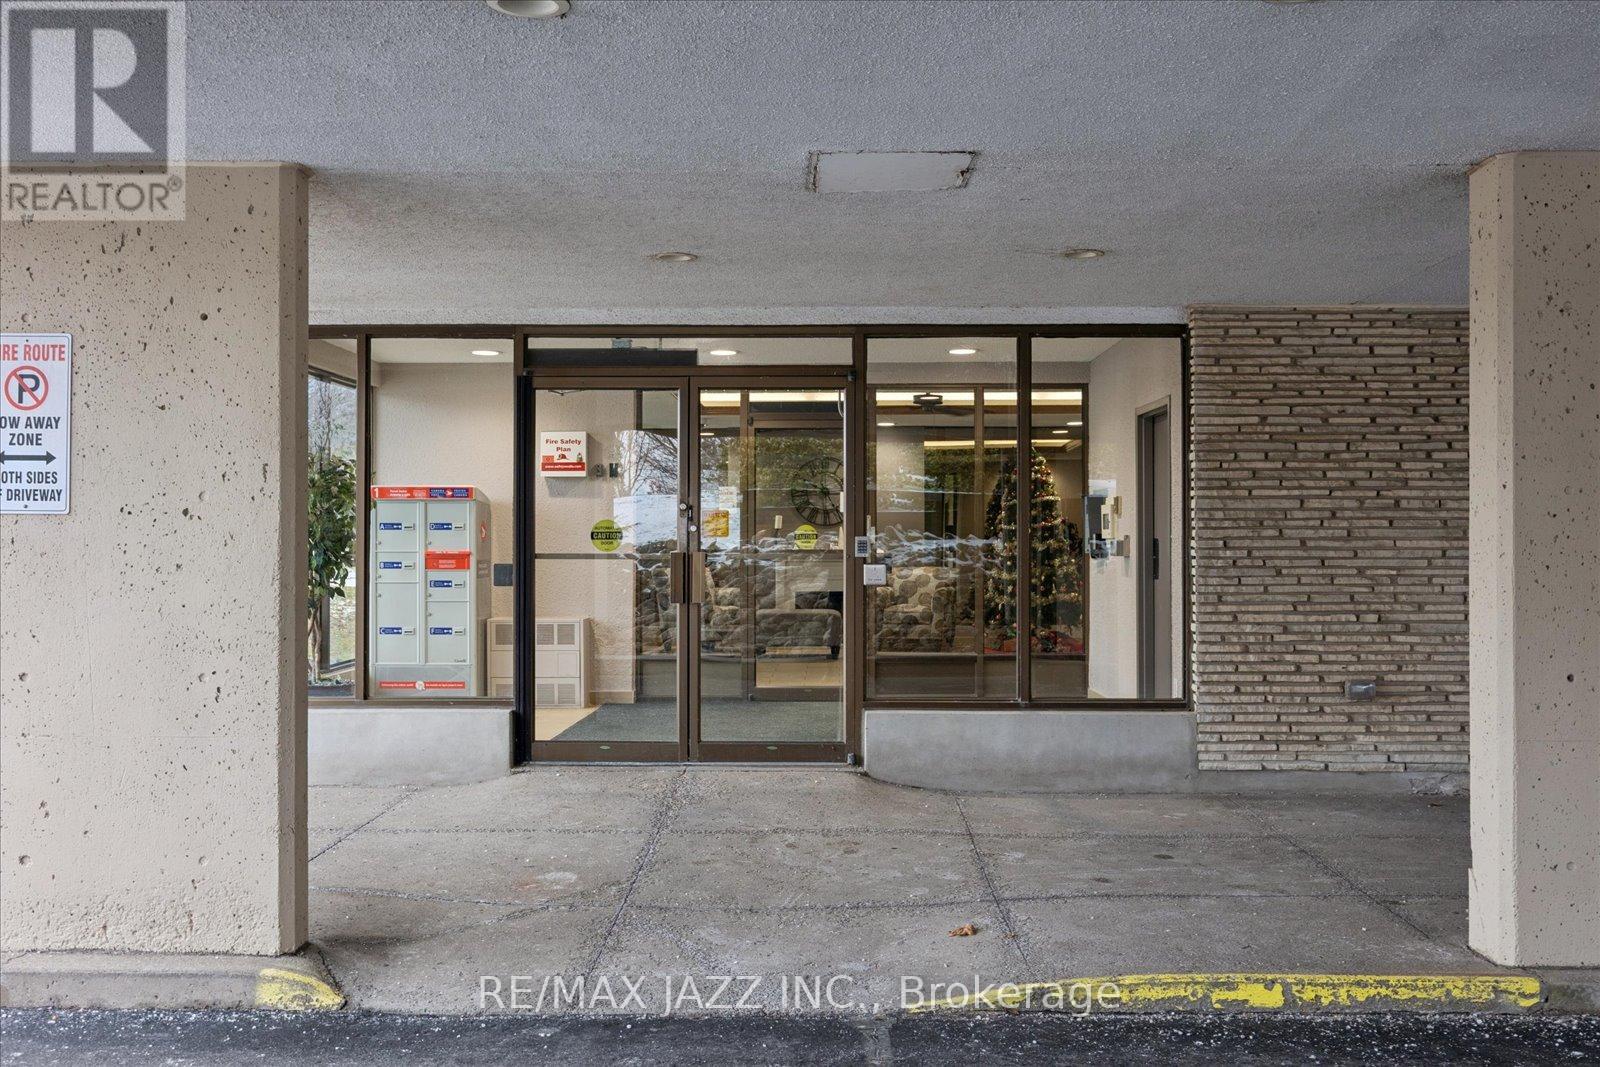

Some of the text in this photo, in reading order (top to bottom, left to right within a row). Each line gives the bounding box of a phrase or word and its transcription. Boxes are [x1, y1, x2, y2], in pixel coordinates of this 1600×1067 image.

[0, 344, 66, 361] RE ROUTE
[24, 416, 61, 429] AWAY
[9, 433, 42, 446] ZONE
[2, 471, 58, 484] OTH SIDES
[6, 489, 63, 502] DRIVEWAY
[373, 487, 379, 498] 1
